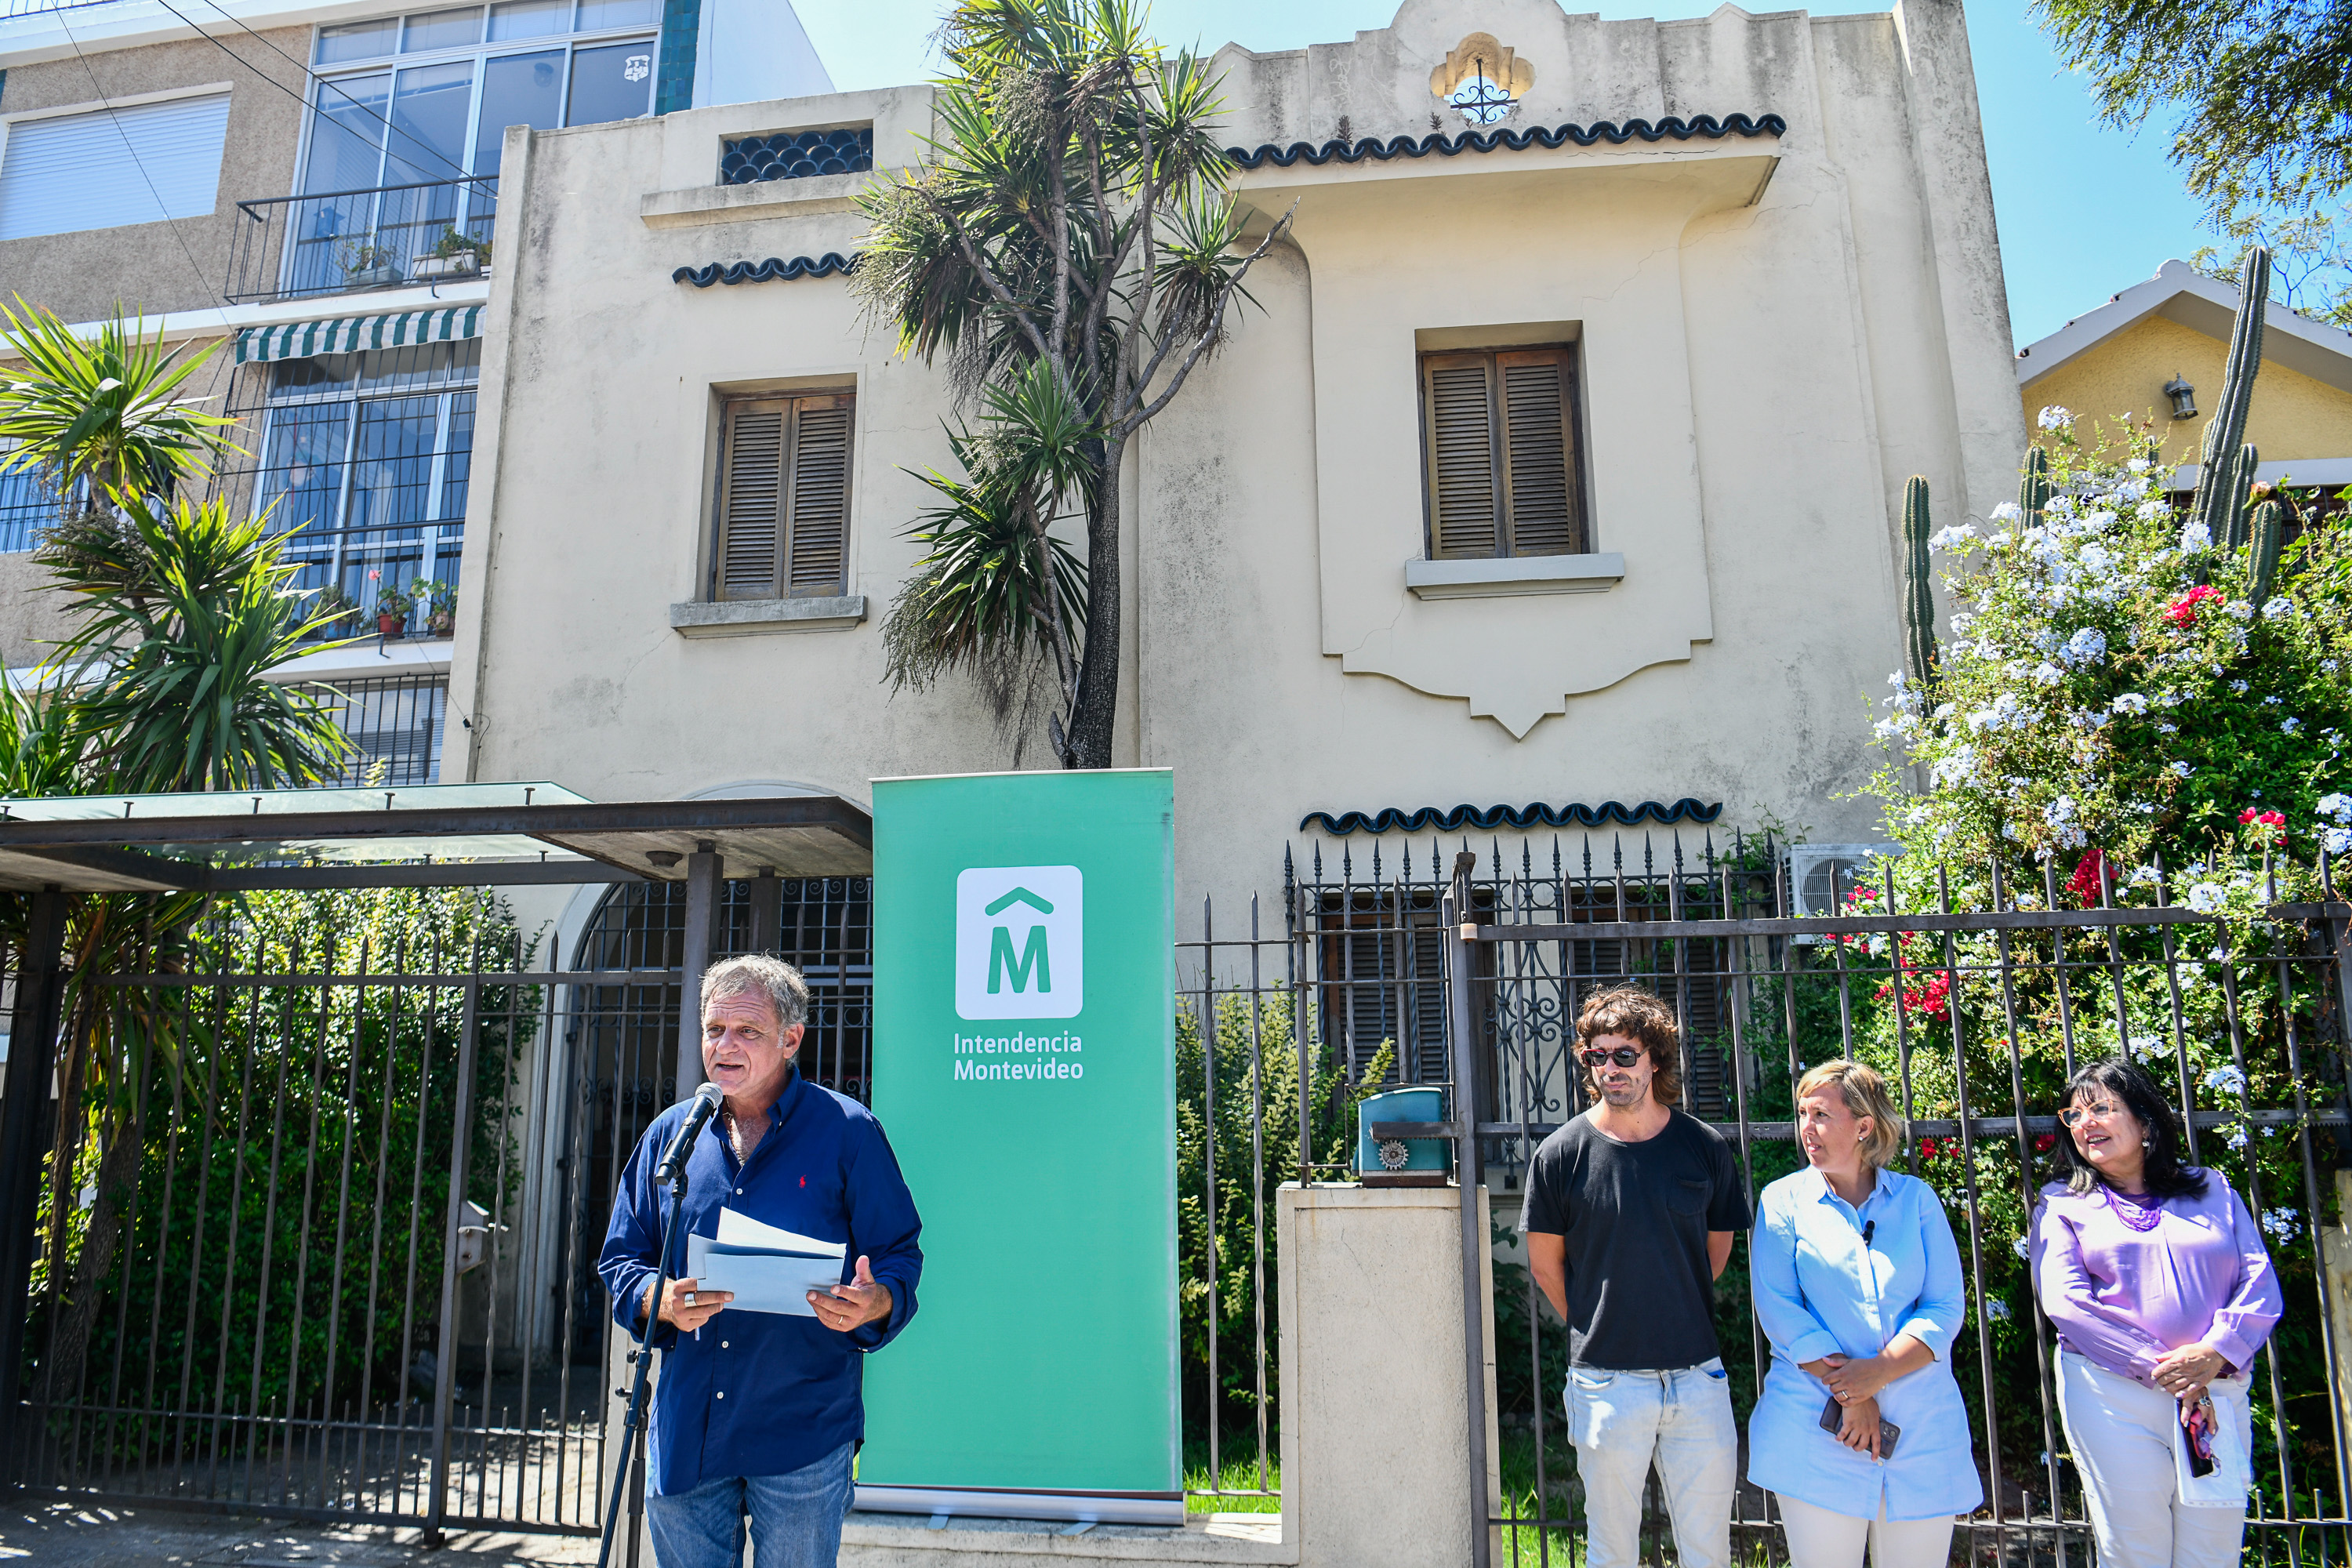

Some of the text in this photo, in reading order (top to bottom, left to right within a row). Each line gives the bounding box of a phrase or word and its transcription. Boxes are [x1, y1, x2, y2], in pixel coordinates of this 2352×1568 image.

[987, 925, 1051, 994] M
[954, 1030, 1082, 1054] Intendencia
[954, 1057, 1083, 1080] Montevideo
